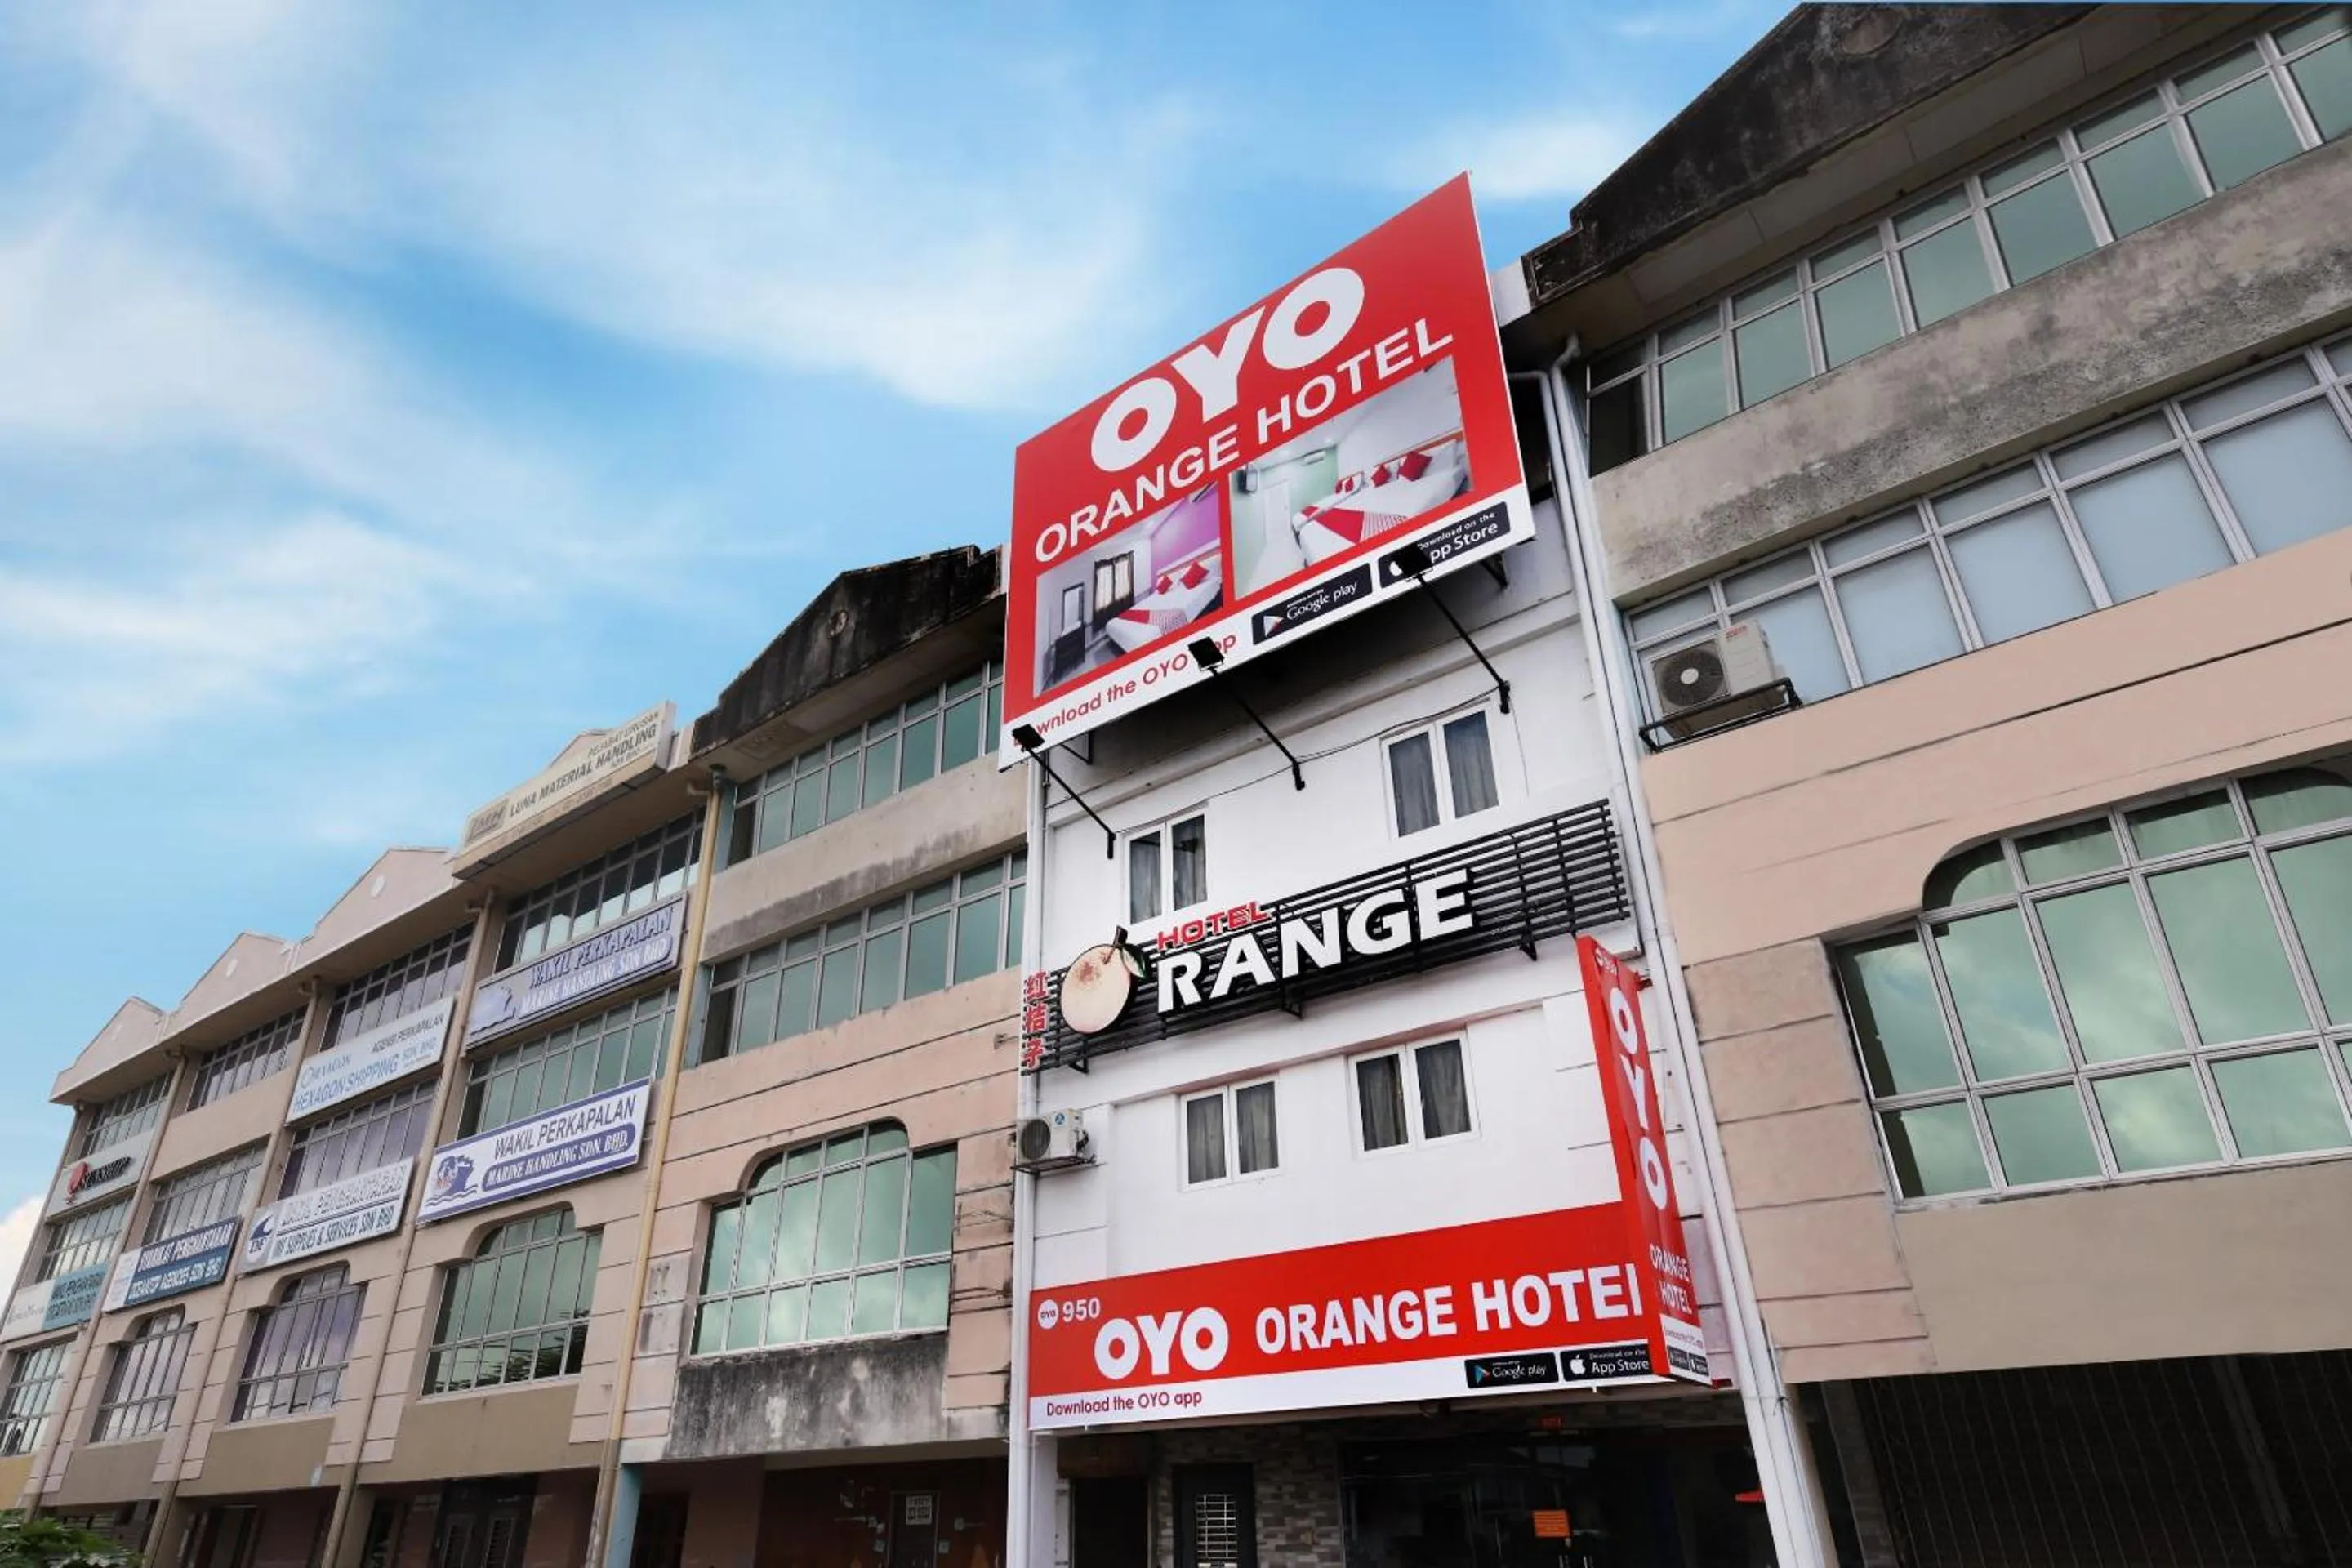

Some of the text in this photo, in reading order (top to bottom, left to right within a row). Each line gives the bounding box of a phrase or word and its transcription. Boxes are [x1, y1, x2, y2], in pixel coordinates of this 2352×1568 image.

[1090, 267, 1365, 473] OYO
[1035, 317, 1454, 563] ORANGE HOTEL
[1464, 520, 1476, 530] on
[1479, 513, 1494, 523] the
[1430, 523, 1498, 564] pp Store
[1286, 594, 1330, 621] Google
[1334, 581, 1357, 602] play
[1014, 654, 1188, 746] wnload the OYO
[539, 760, 592, 800] MATERIAL
[595, 724, 657, 768] HANDLING
[1156, 901, 1274, 950] HOTEL
[293, 1079, 346, 1113] HEXAGON
[346, 1054, 400, 1092] SHIPPING
[1608, 987, 1668, 1210] OYO
[493, 1094, 638, 1160] WAKIL PERKAPALAN
[488, 1164, 525, 1187] MARINE
[525, 1146, 577, 1177] HANDLING
[1649, 1243, 1690, 1282] ORANGE
[1062, 1297, 1100, 1322] 950
[1659, 1280, 1692, 1315] HOTEL
[1094, 1307, 1229, 1380] OYO
[1256, 1285, 1458, 1354] ORANGE
[1492, 1364, 1547, 1379] Google play
[1592, 1359, 1649, 1375] App Store
[1047, 1392, 1202, 1416] Download the OYO app
